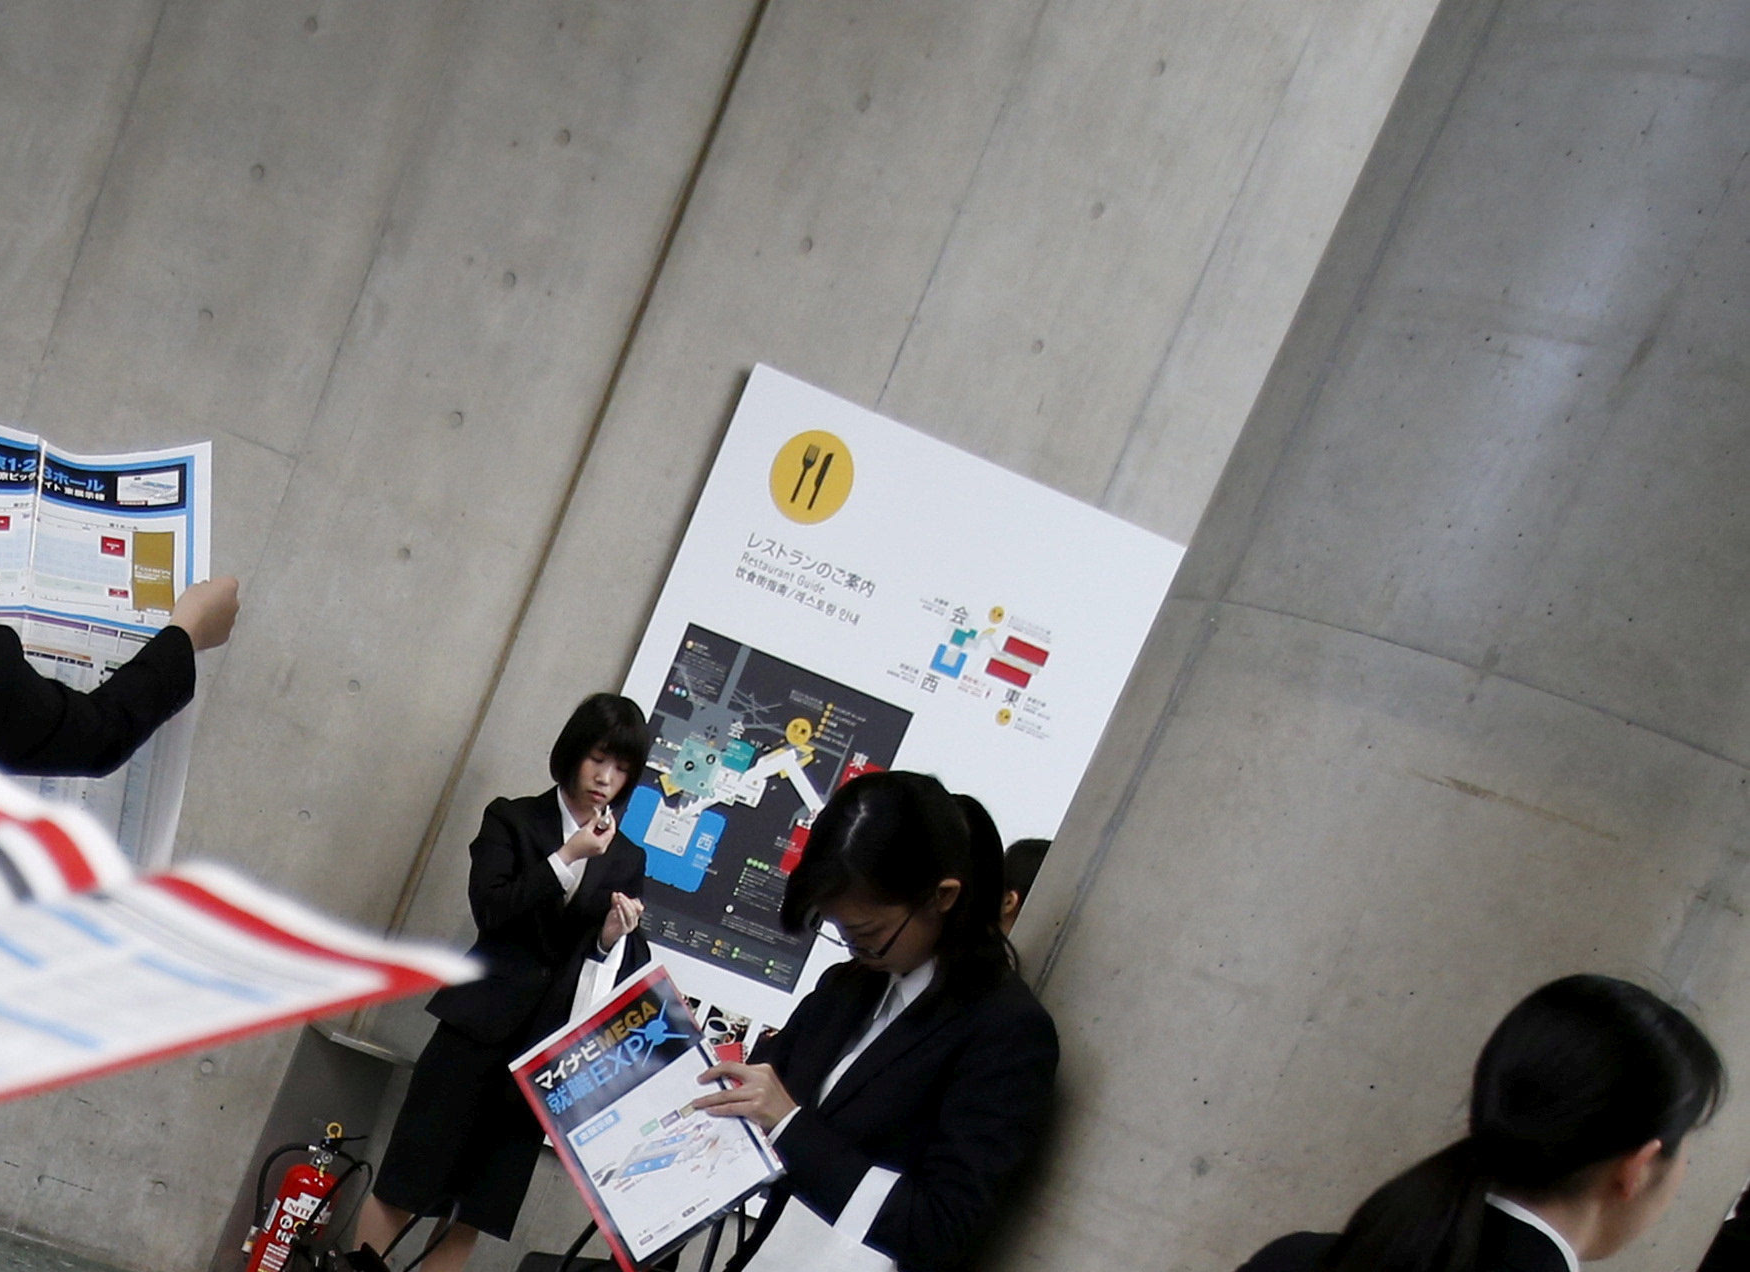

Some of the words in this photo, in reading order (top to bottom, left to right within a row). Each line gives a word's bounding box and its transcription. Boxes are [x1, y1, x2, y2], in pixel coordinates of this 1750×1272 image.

[741, 552, 794, 582] Restaurant
[797, 575, 825, 595] Guide
[747, 532, 876, 599] レストランのご案内
[950, 606, 969, 626] 会
[920, 672, 941, 693] 西
